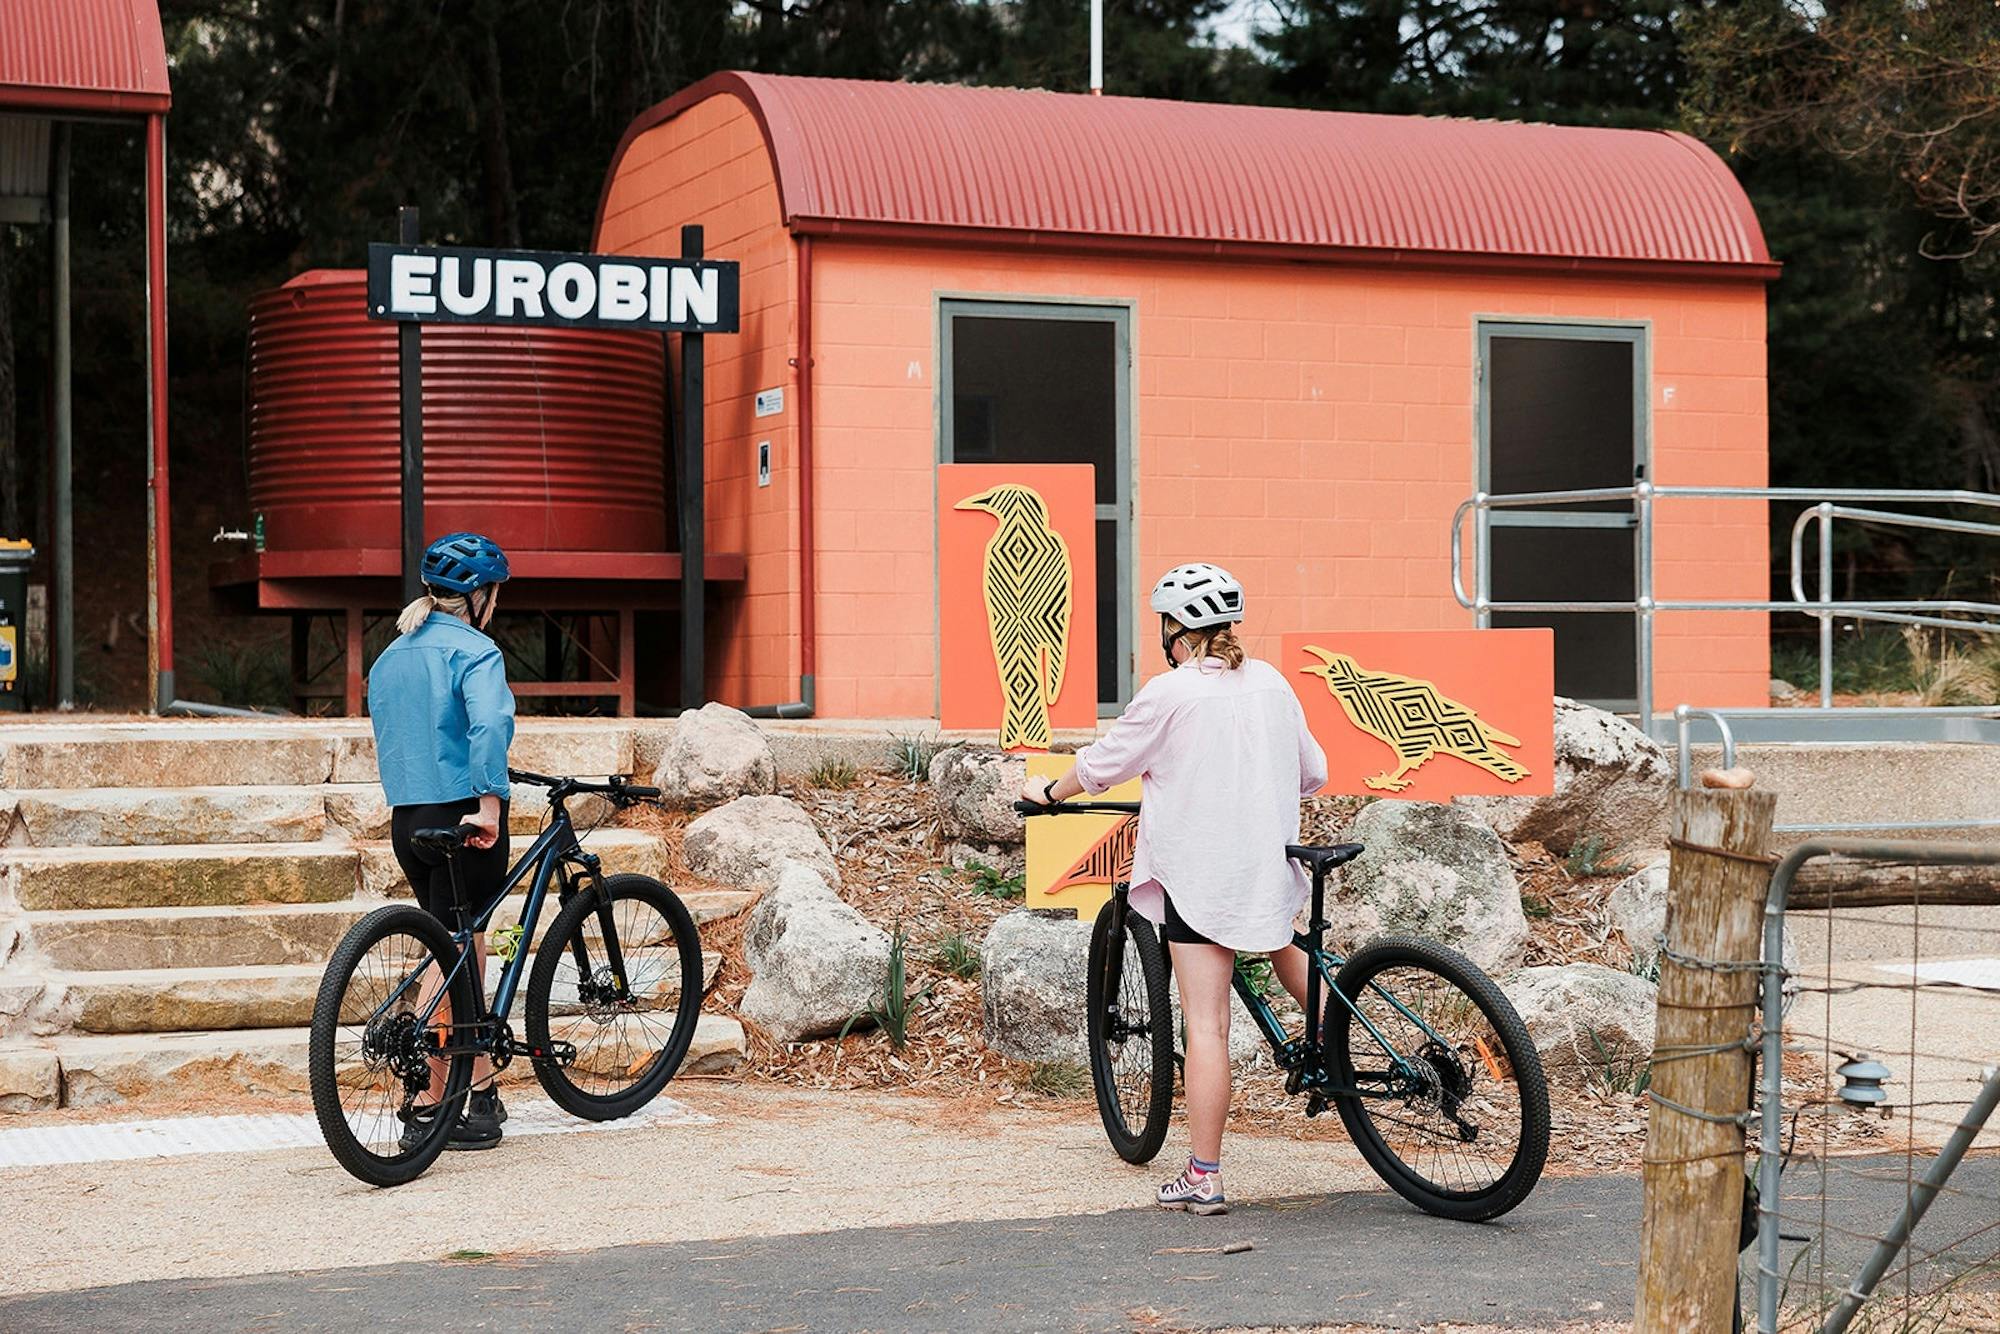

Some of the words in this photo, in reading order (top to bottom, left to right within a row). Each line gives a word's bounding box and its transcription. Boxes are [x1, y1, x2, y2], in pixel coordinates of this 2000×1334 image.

[391, 254, 719, 324] EUROBIN
[907, 360, 922, 379] M
[1663, 387, 1676, 405] F
